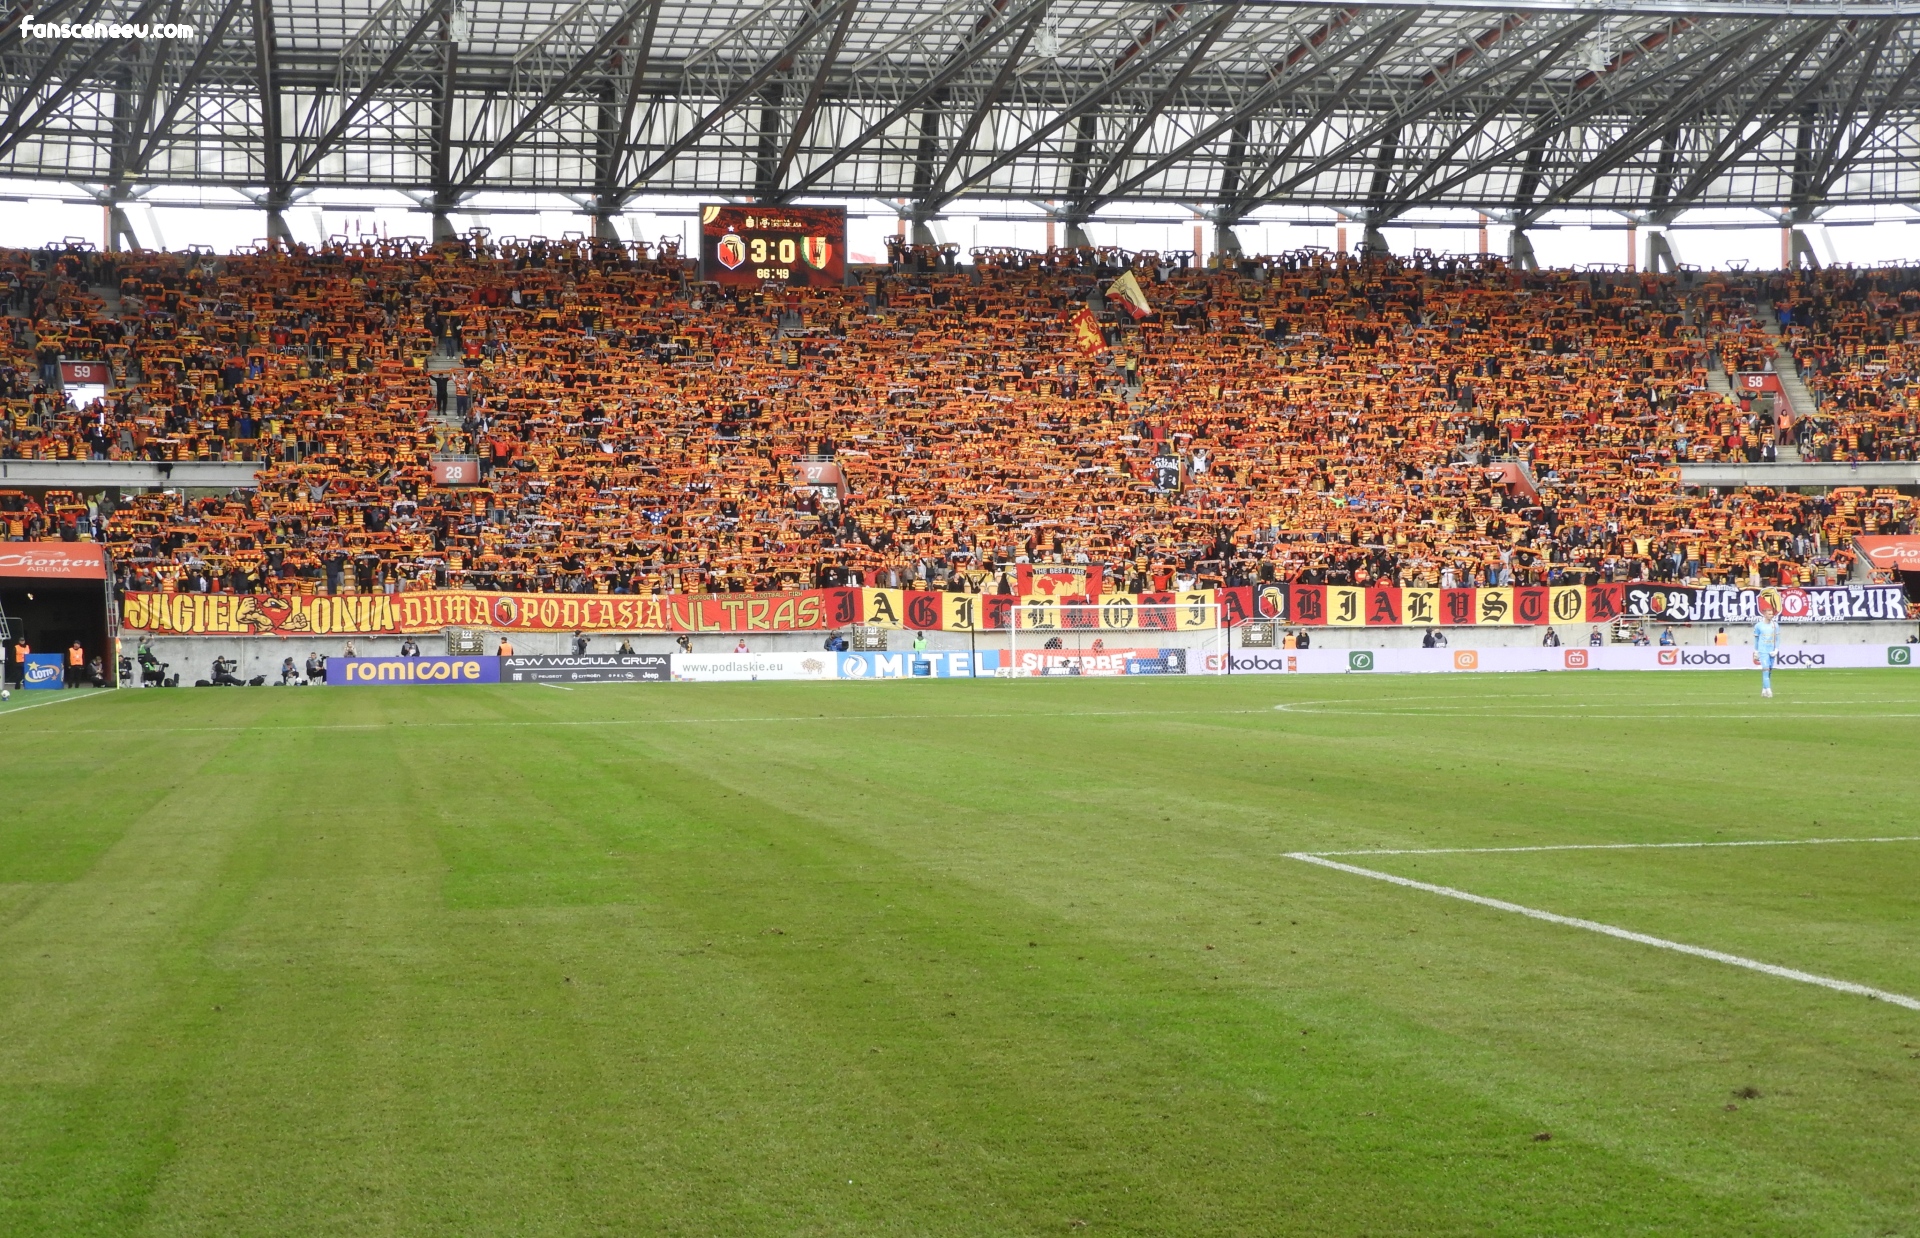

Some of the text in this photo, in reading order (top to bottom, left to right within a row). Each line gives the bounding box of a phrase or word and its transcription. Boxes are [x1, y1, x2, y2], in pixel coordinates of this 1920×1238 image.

[750, 238, 796, 264] 3:0
[756, 268, 790, 279] 86:49
[74, 365, 91, 378] 59
[1748, 375, 1763, 388] 58
[445, 466, 463, 479] 28
[807, 466, 823, 479] 27
[0, 553, 100, 567] Chorten
[1689, 589, 1757, 621] JAGA
[1810, 588, 1906, 619] MAZUR
[402, 595, 666, 629] DUMA PODLASIA
[671, 596, 821, 632] ULTRAS
[505, 656, 667, 666] ASW WOJCIULA GRUPA
[1230, 654, 1283, 671] koba
[1571, 655, 1582, 663] tv
[1681, 650, 1731, 665] koba
[1776, 650, 1825, 665] koba
[346, 660, 481, 681] romicore
[682, 661, 784, 674] www.podlaskie.eu
[874, 652, 995, 678] MITEL
[32, 668, 54, 680] LOTTO
[642, 671, 660, 680] Jeep
